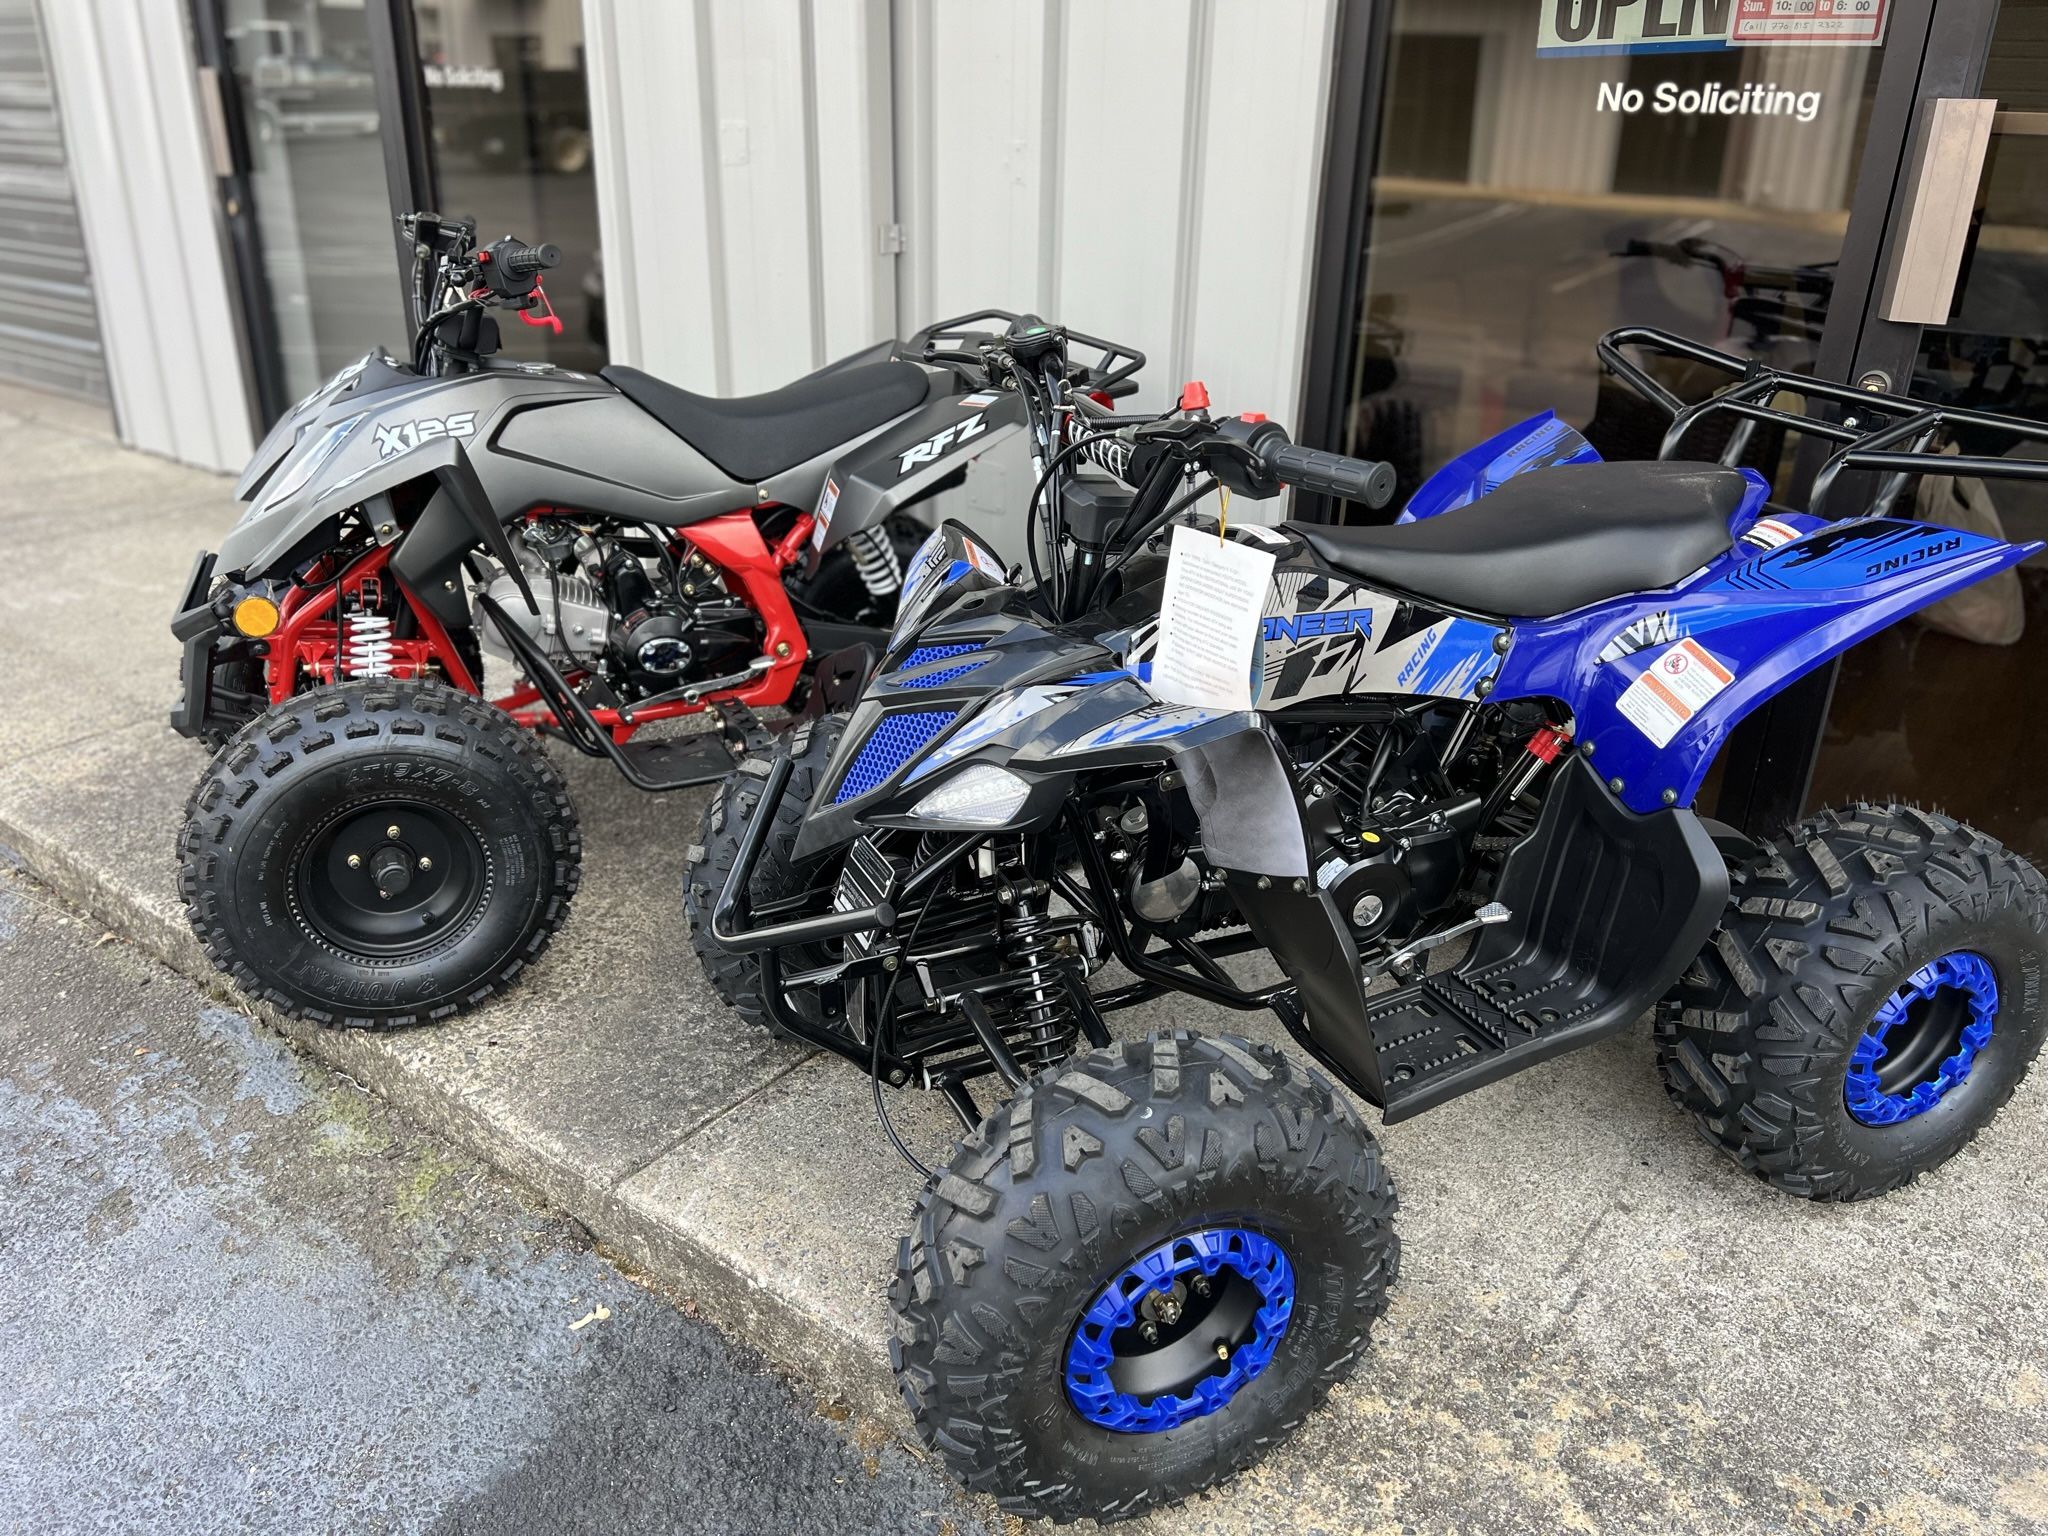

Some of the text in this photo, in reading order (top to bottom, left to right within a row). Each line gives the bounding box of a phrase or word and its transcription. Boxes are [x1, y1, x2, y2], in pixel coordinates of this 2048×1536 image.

[1743, 0, 1765, 12] Sun.
[1819, 0, 1831, 11] to
[1597, 82, 1821, 121] No Soliciting
[897, 411, 987, 475] RFZ
[1506, 424, 1554, 458] RACING
[1865, 536, 1961, 578] RACING
[1396, 627, 1439, 688] RACING
